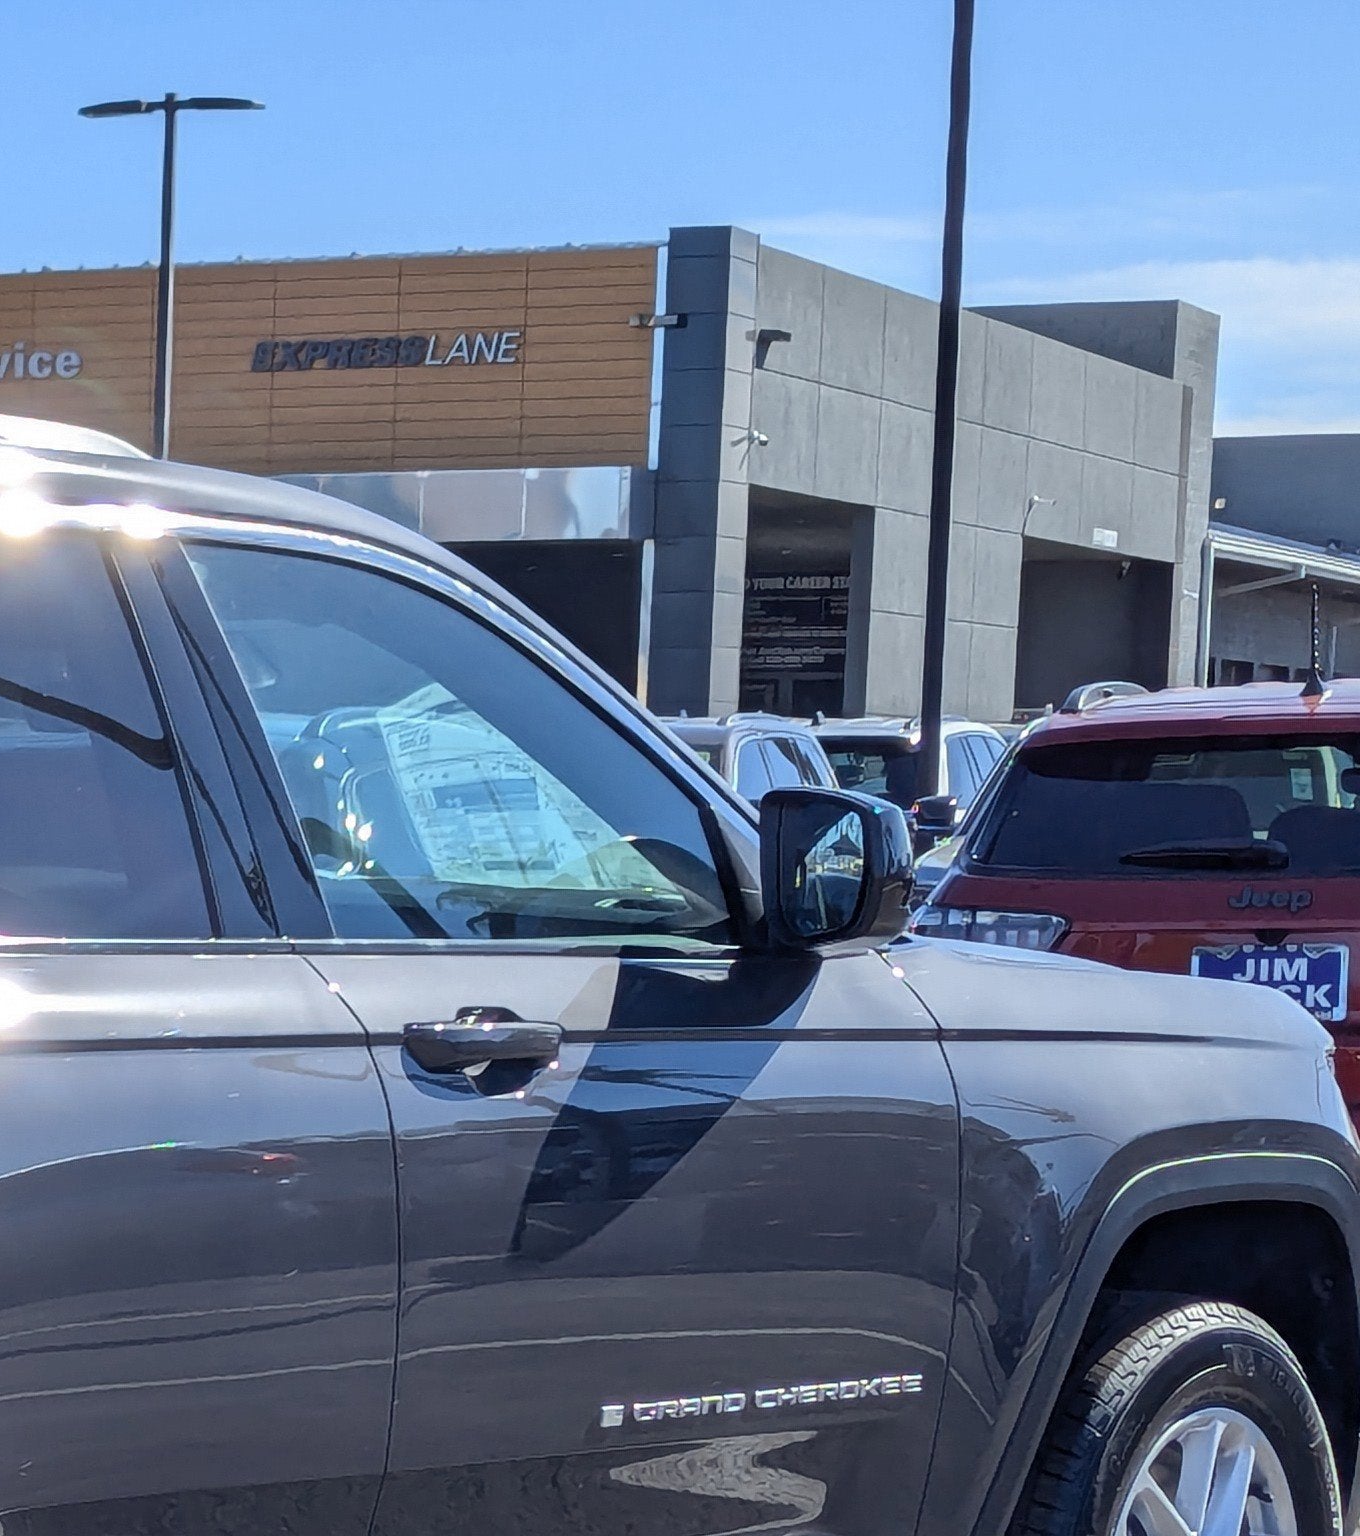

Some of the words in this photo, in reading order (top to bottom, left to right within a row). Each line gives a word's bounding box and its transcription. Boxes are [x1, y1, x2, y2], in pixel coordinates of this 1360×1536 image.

[1229, 886, 1313, 913] Jeep
[1232, 957, 1308, 982] JIM
[633, 1392, 746, 1422] GRAND
[755, 1374, 924, 1409] CHEROKEE
